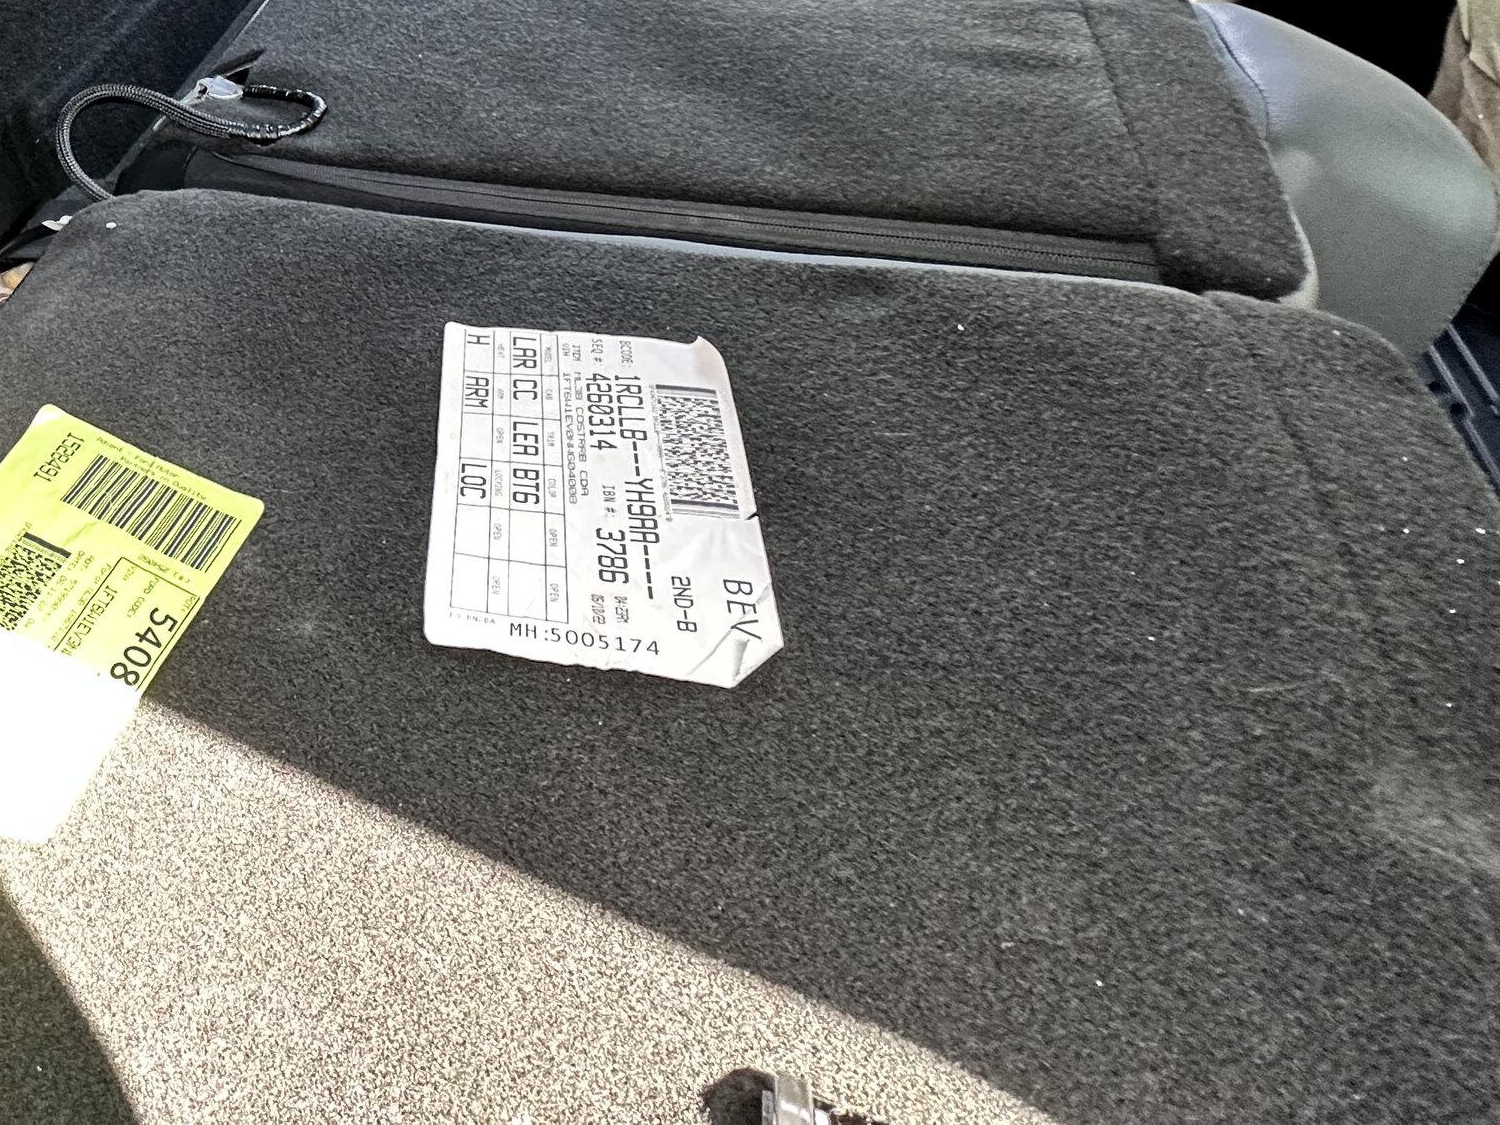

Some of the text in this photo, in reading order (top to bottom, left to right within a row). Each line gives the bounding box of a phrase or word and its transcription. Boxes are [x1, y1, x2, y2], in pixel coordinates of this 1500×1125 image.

[590, 338, 604, 354] SEQ
[460, 334, 490, 499] H ARM LOC
[545, 389, 554, 401] CAB
[586, 373, 618, 451] 4260314
[512, 337, 540, 505] LAR CC LEA BT6
[33, 432, 85, 483] 1528491
[548, 478, 556, 498] COLOR
[602, 485, 616, 502] IBN
[493, 523, 502, 541] OPEN
[548, 529, 558, 547] OPEN
[596, 528, 629, 583] 3786
[550, 583, 560, 603] OPEN
[671, 576, 697, 633] 2ND-B
[723, 579, 762, 641] BEV
[110, 607, 179, 687] 5408
